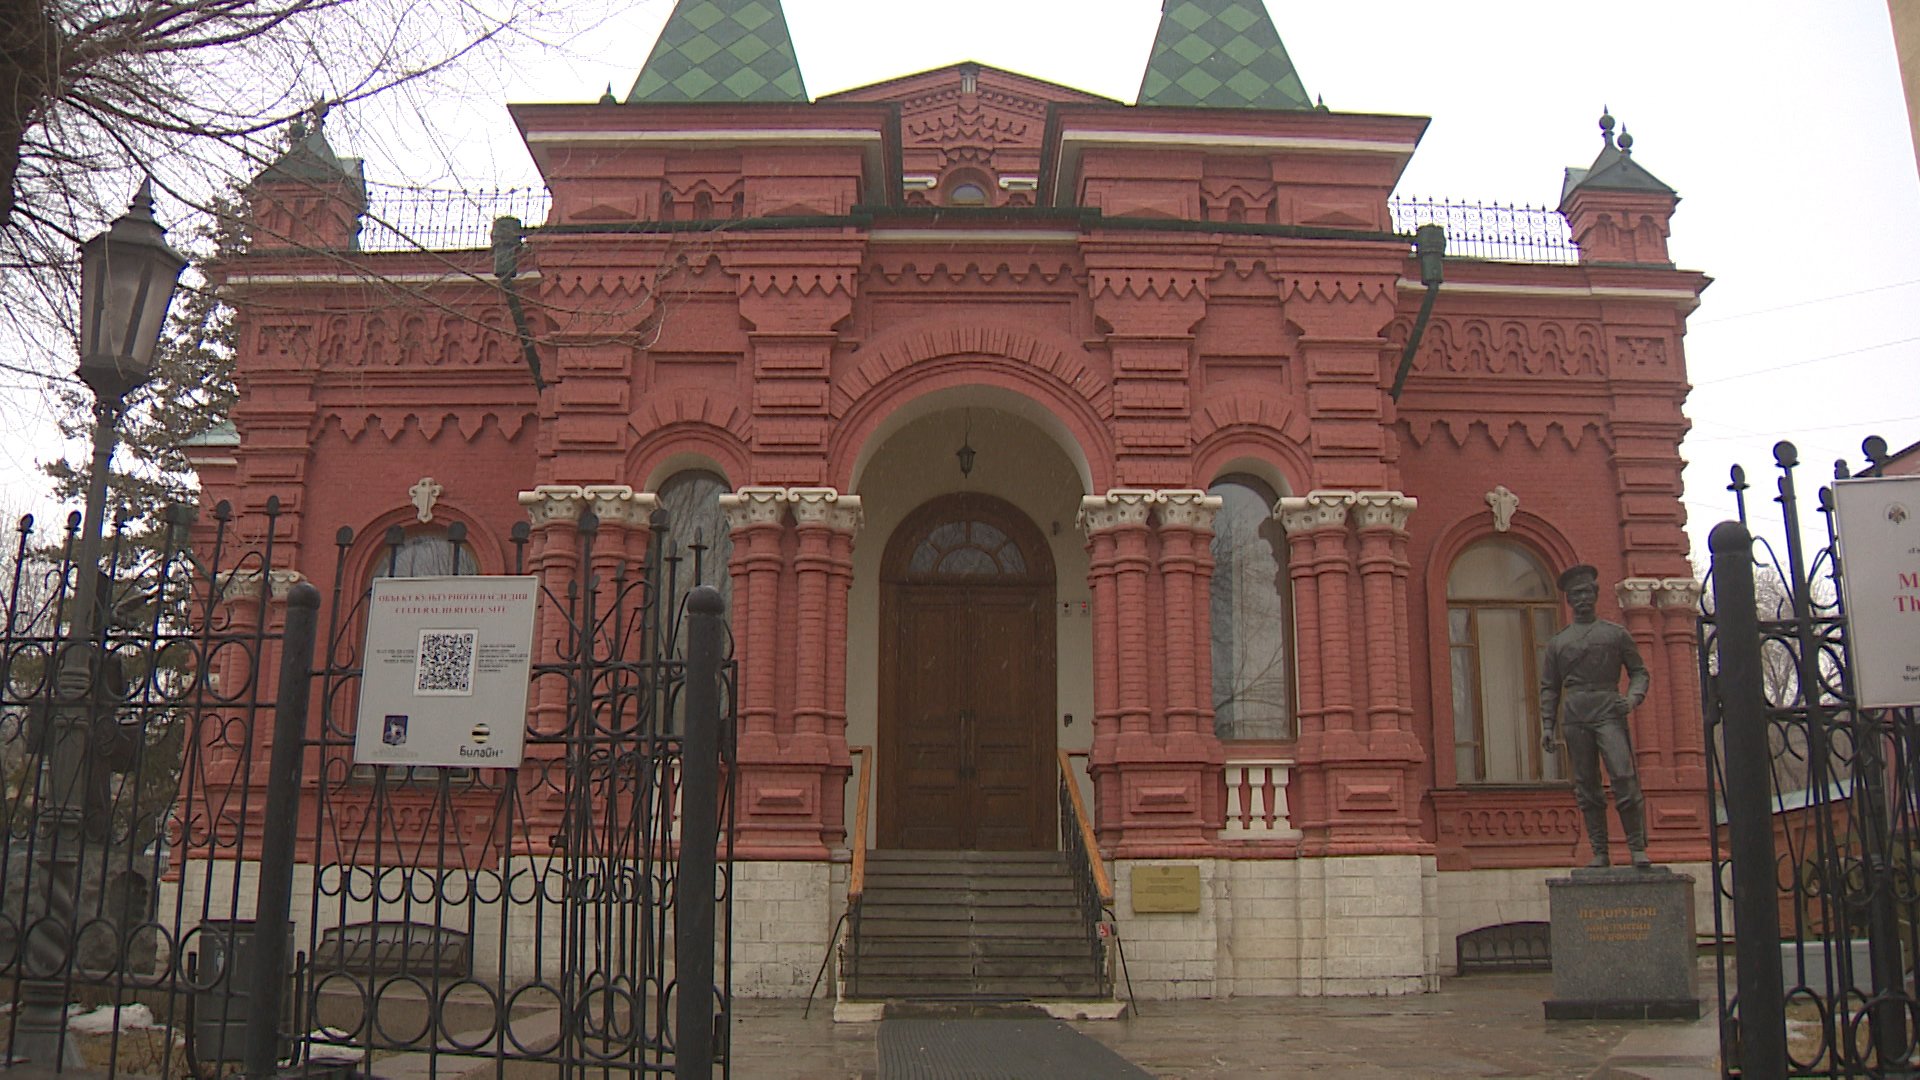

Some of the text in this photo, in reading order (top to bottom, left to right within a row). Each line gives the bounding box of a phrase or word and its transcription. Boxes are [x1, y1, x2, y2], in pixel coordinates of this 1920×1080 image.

[378, 594, 412, 602] ОБЪЕКТ
[395, 606, 441, 614] CULTURAL
[442, 606, 484, 614] HERITAGE
[459, 745, 499, 758] Билайн
